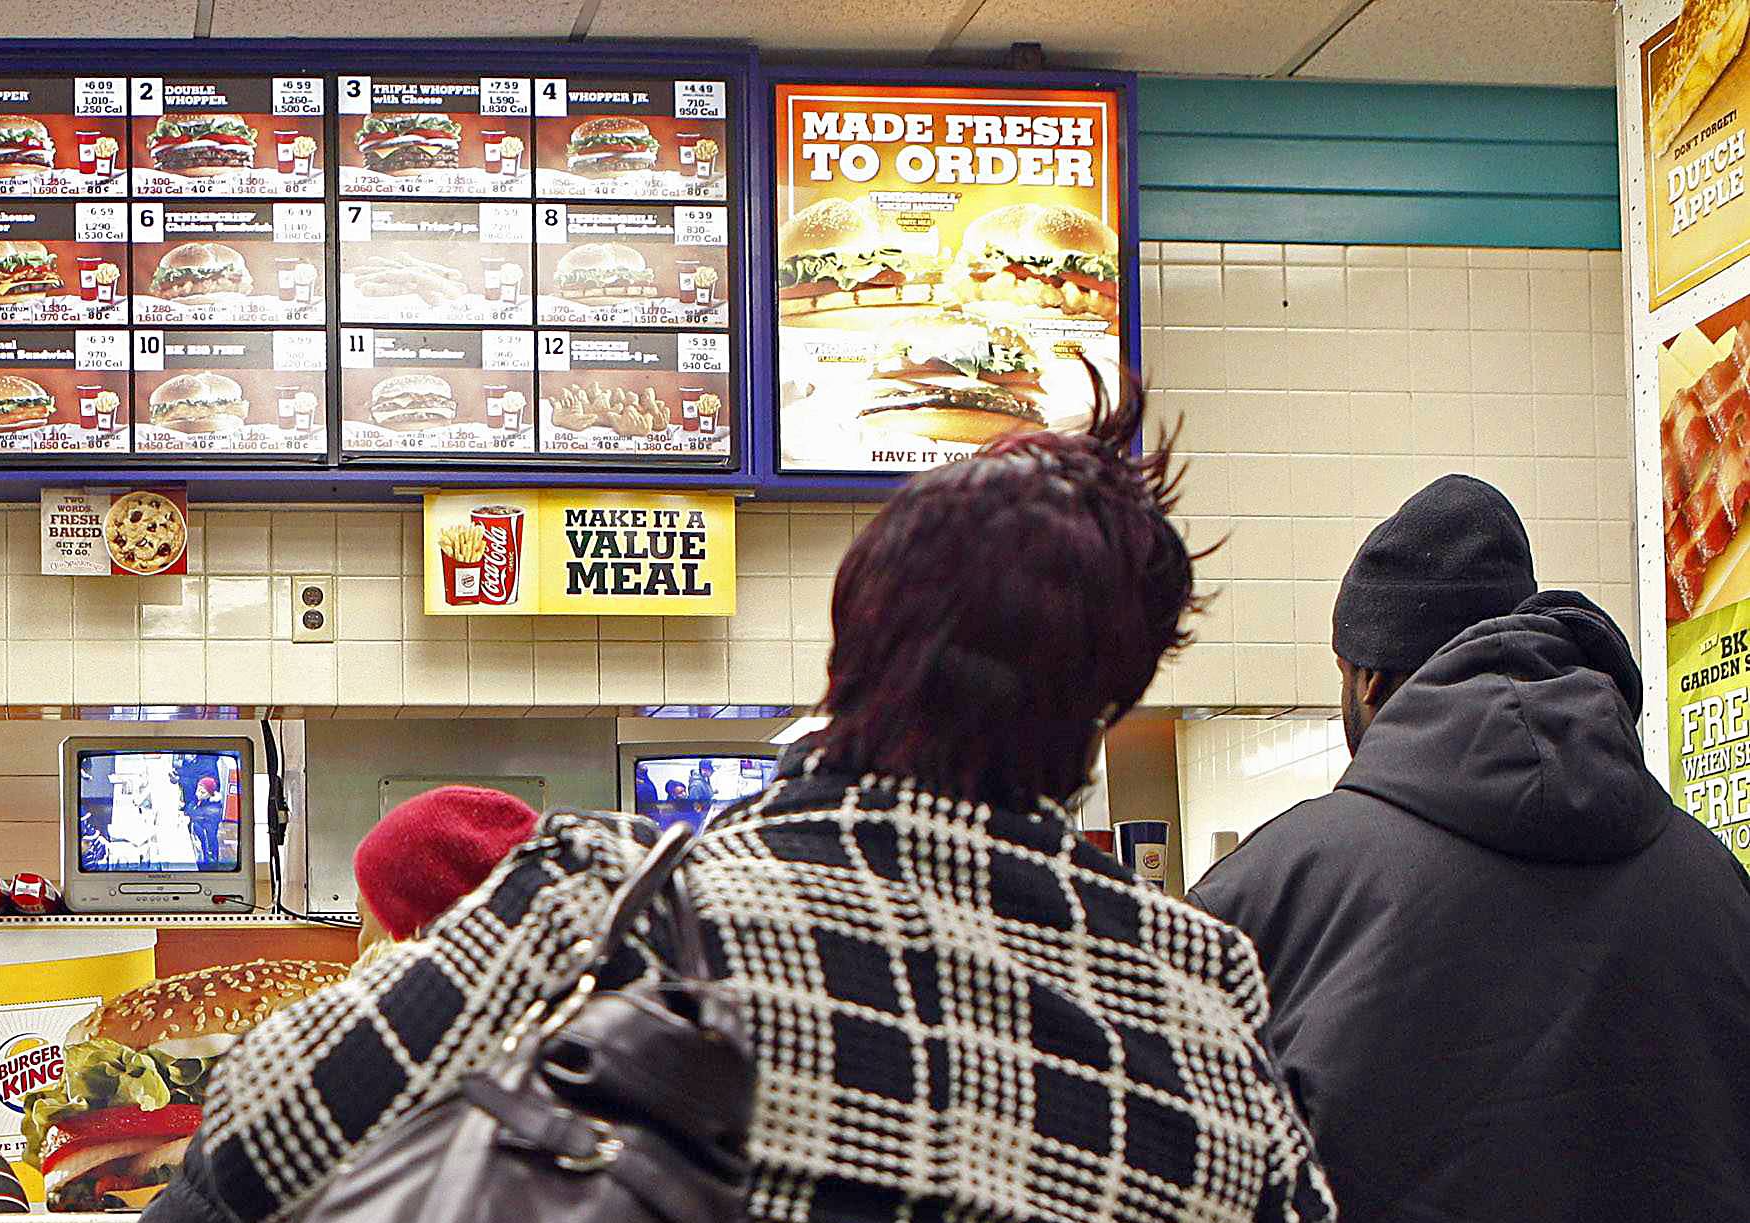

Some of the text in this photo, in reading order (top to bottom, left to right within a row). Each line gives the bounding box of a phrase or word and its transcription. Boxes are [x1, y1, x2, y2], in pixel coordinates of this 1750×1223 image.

[139, 82, 216, 100] 2 DOUBLE
[346, 80, 480, 98] 3 TRIPLE WHOPPER
[373, 94, 443, 104] with Cheese
[542, 82, 557, 100] 4
[568, 92, 630, 103] WHOPPER
[165, 95, 228, 105] WHOPPER
[801, 111, 1094, 147] MADE FRESH
[1674, 109, 1738, 160] DON'T FORGET!
[802, 143, 1095, 187] TO ORDER
[1667, 128, 1746, 205] DUTCH
[1671, 165, 1745, 238] APPLE
[140, 210, 154, 228] 6
[348, 207, 362, 224] 7
[544, 209, 558, 227] 8
[140, 336, 159, 354] 10
[349, 335, 365, 352] 11
[544, 337, 564, 355] 12
[17, 350, 75, 360] Sandwich
[871, 450, 917, 463] HAVE
[921, 451, 938, 463] IT
[565, 509, 705, 529] MAKE IT A
[565, 530, 706, 559] VALUE
[566, 562, 711, 595] MEAL
[1720, 629, 1748, 659] BK
[1680, 657, 1740, 693] GARDEN
[1680, 686, 1750, 756] FRE
[1681, 748, 1732, 782] WHEN
[1683, 769, 1750, 830] FRE
[2, 1059, 64, 1100] KING
